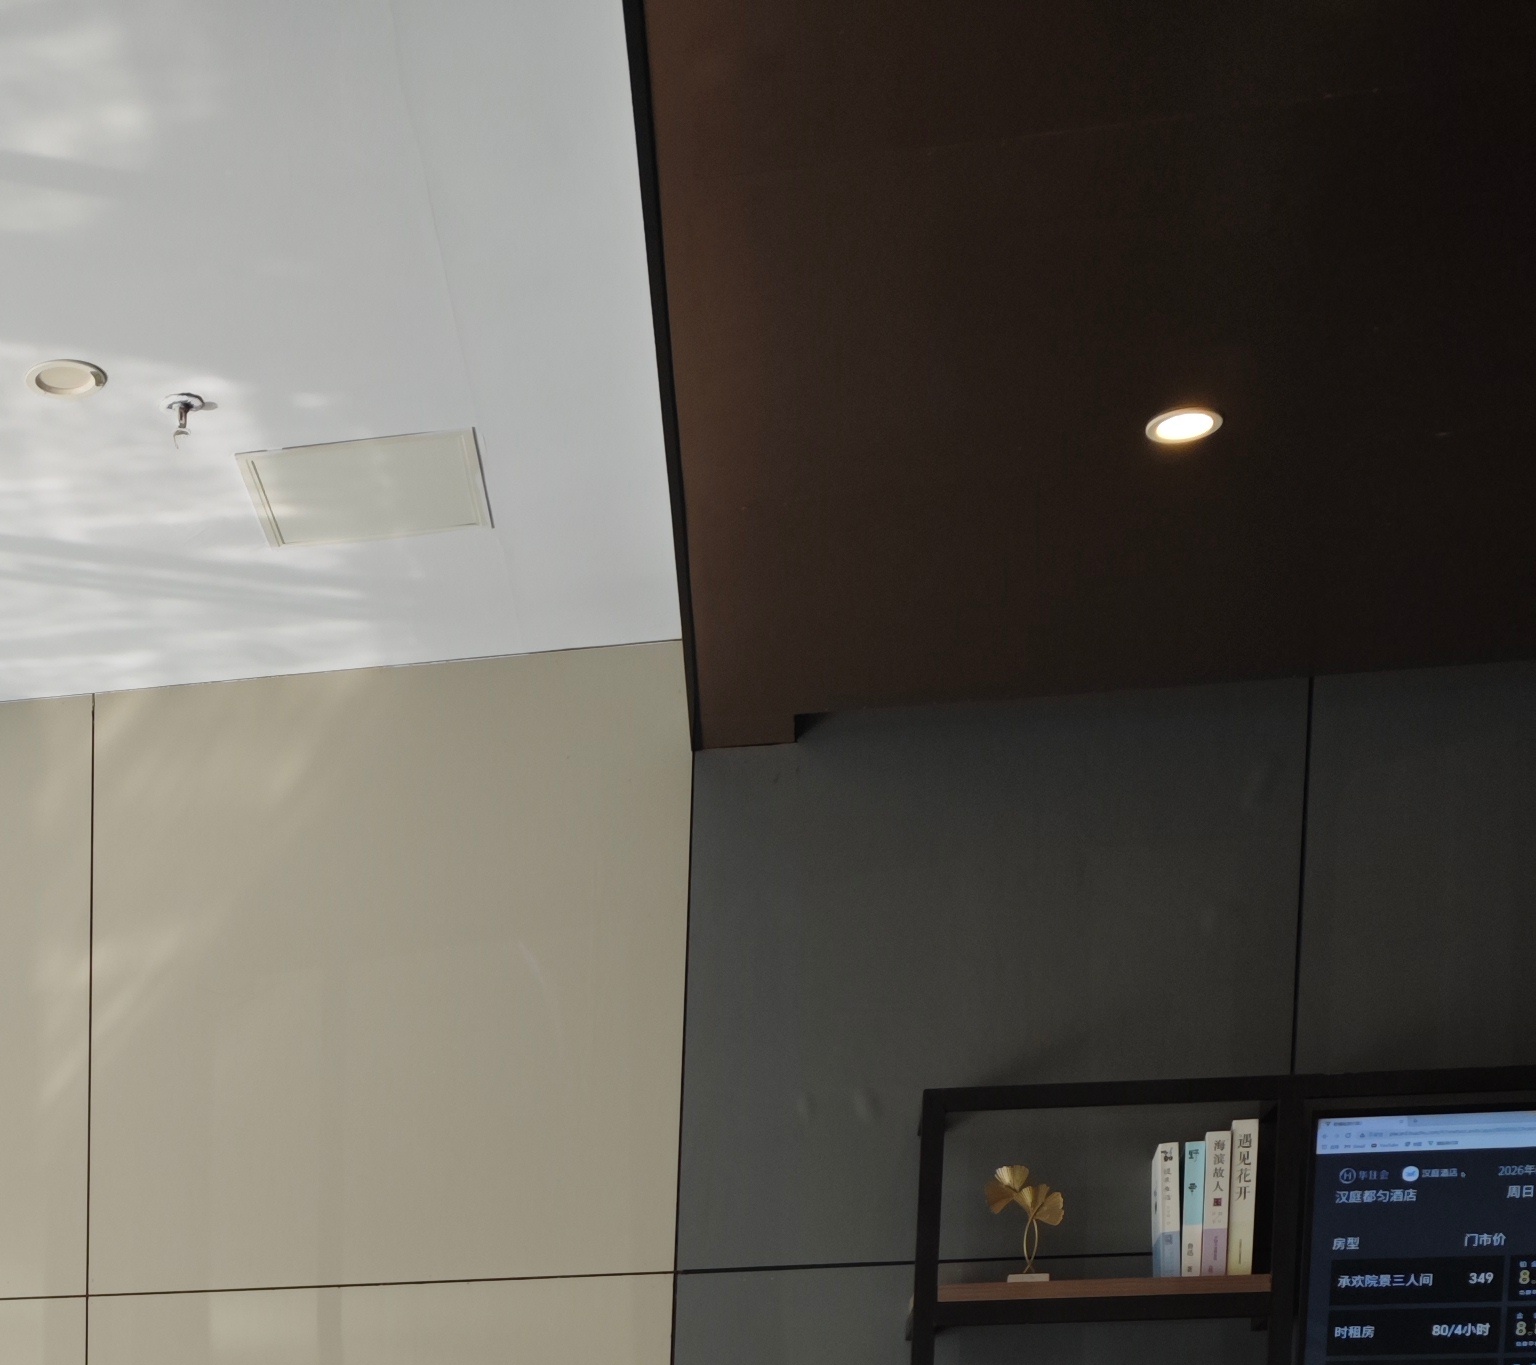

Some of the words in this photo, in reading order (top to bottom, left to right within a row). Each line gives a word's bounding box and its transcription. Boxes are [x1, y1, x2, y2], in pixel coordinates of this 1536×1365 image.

[1212, 1139, 1226, 1192] 海滨故人
[1237, 1133, 1252, 1201] 遇见花开
[1421, 1167, 1459, 1179] 汉庭酒店
[1498, 1164, 1536, 1178] 2026年
[1335, 1188, 1418, 1204] 汉庭都匀酒店
[1506, 1184, 1535, 1199] 周日
[1331, 1236, 1361, 1251] 房型
[1463, 1232, 1507, 1248] 门市价
[1336, 1272, 1435, 1289] 承欢院景三人间
[1468, 1271, 1495, 1285] 349
[1334, 1325, 1376, 1339] 时租房
[1431, 1322, 1491, 1339] 80/4小时
